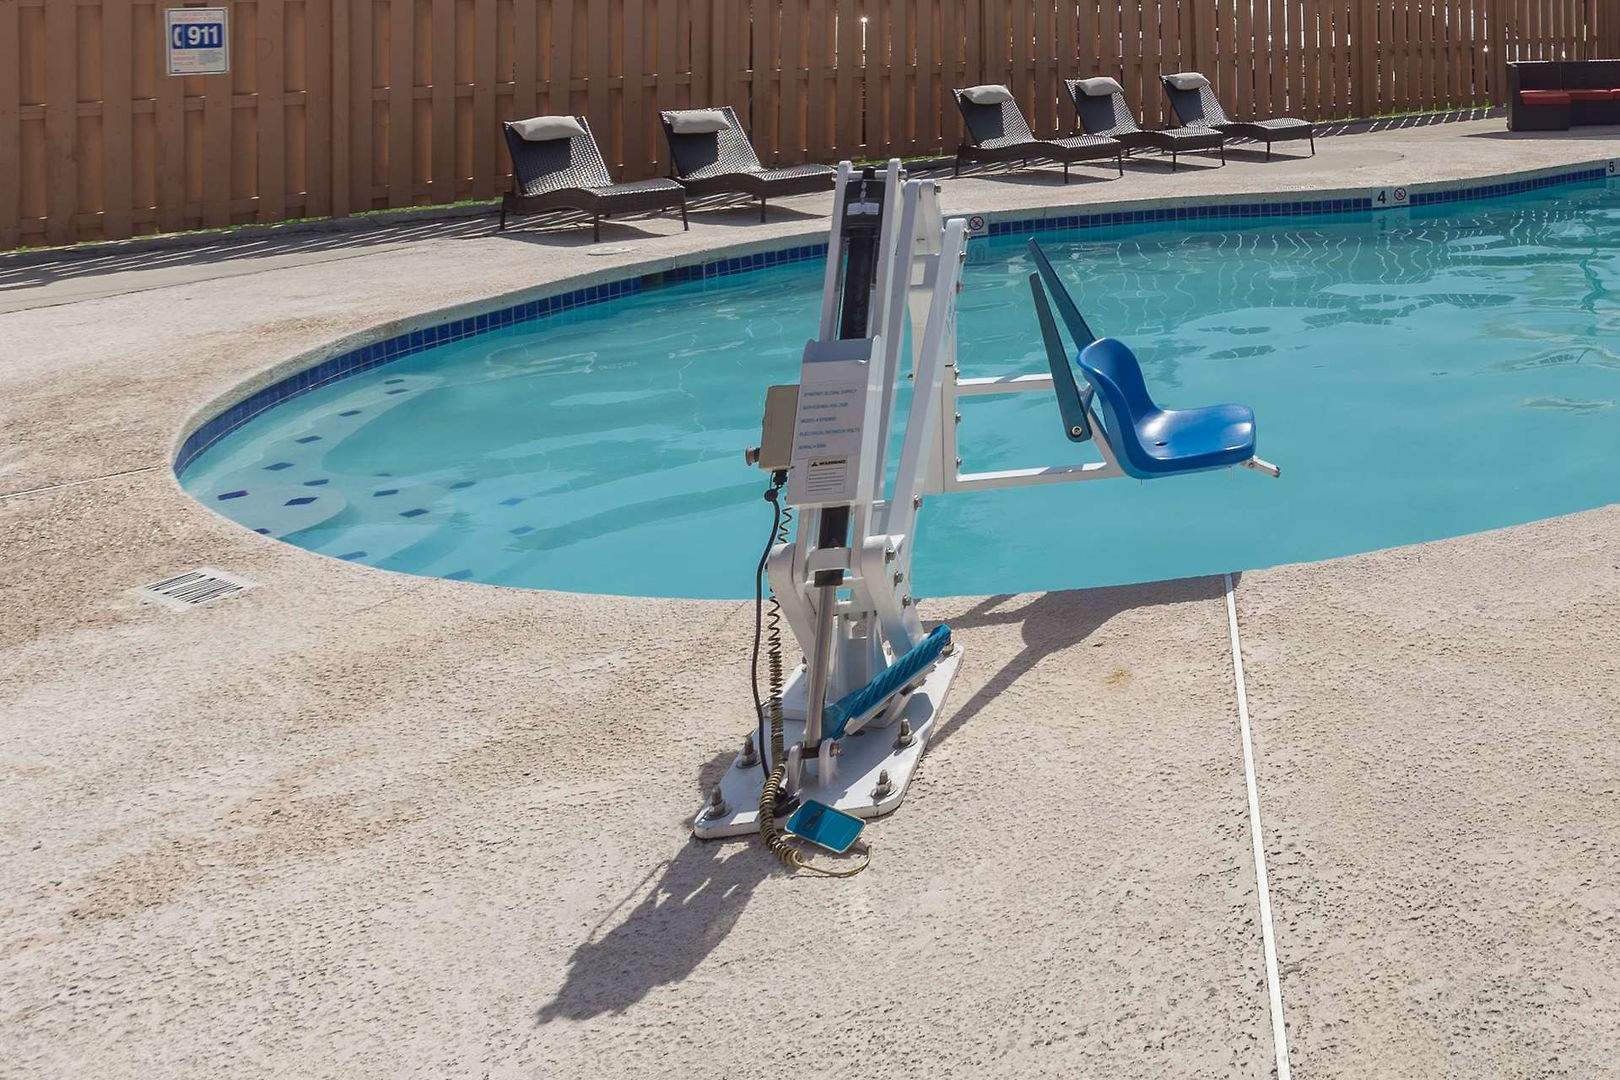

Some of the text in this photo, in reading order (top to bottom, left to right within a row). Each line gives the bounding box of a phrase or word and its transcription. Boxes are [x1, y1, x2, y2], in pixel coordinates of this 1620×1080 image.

[187, 26, 219, 46] 911
[1608, 161, 1615, 173] 5
[1377, 190, 1387, 204] 4
